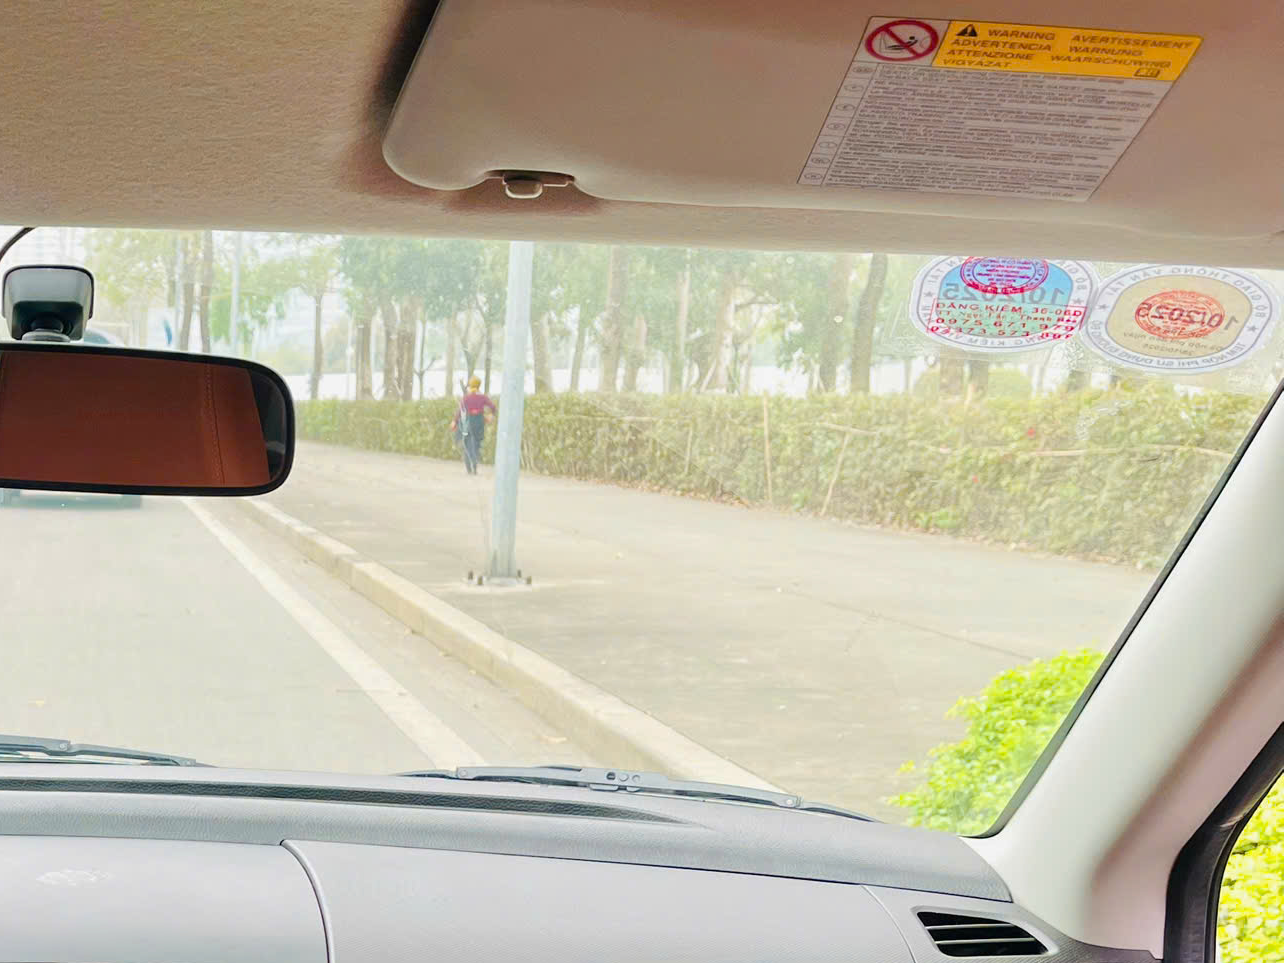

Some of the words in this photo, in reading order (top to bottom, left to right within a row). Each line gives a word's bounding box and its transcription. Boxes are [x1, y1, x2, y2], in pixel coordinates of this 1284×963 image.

[987, 28, 1056, 41] WARNING
[951, 38, 1052, 51] ADVERTENCIA
[1070, 34, 1194, 49] AVERTISSEMENT
[946, 49, 1036, 61] ATTENZIONE
[1068, 45, 1143, 57] WARNUNG
[1050, 54, 1172, 68] WAARSCHUWING
